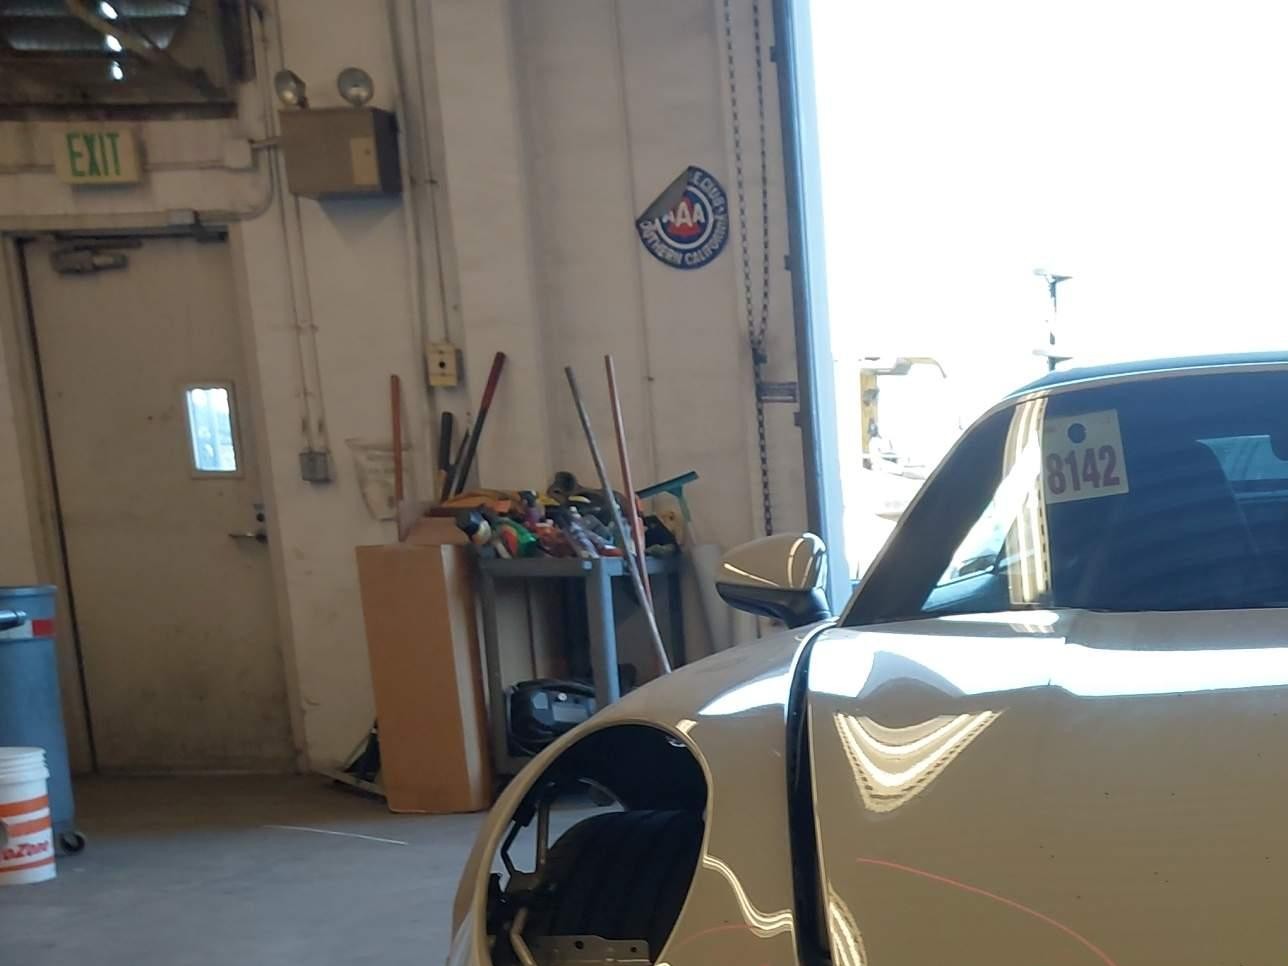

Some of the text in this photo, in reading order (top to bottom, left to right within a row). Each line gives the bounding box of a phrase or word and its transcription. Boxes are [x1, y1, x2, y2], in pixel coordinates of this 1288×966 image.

[66, 131, 121, 177] EXIT
[662, 200, 706, 228] AAA
[1045, 445, 1121, 495] 8142
